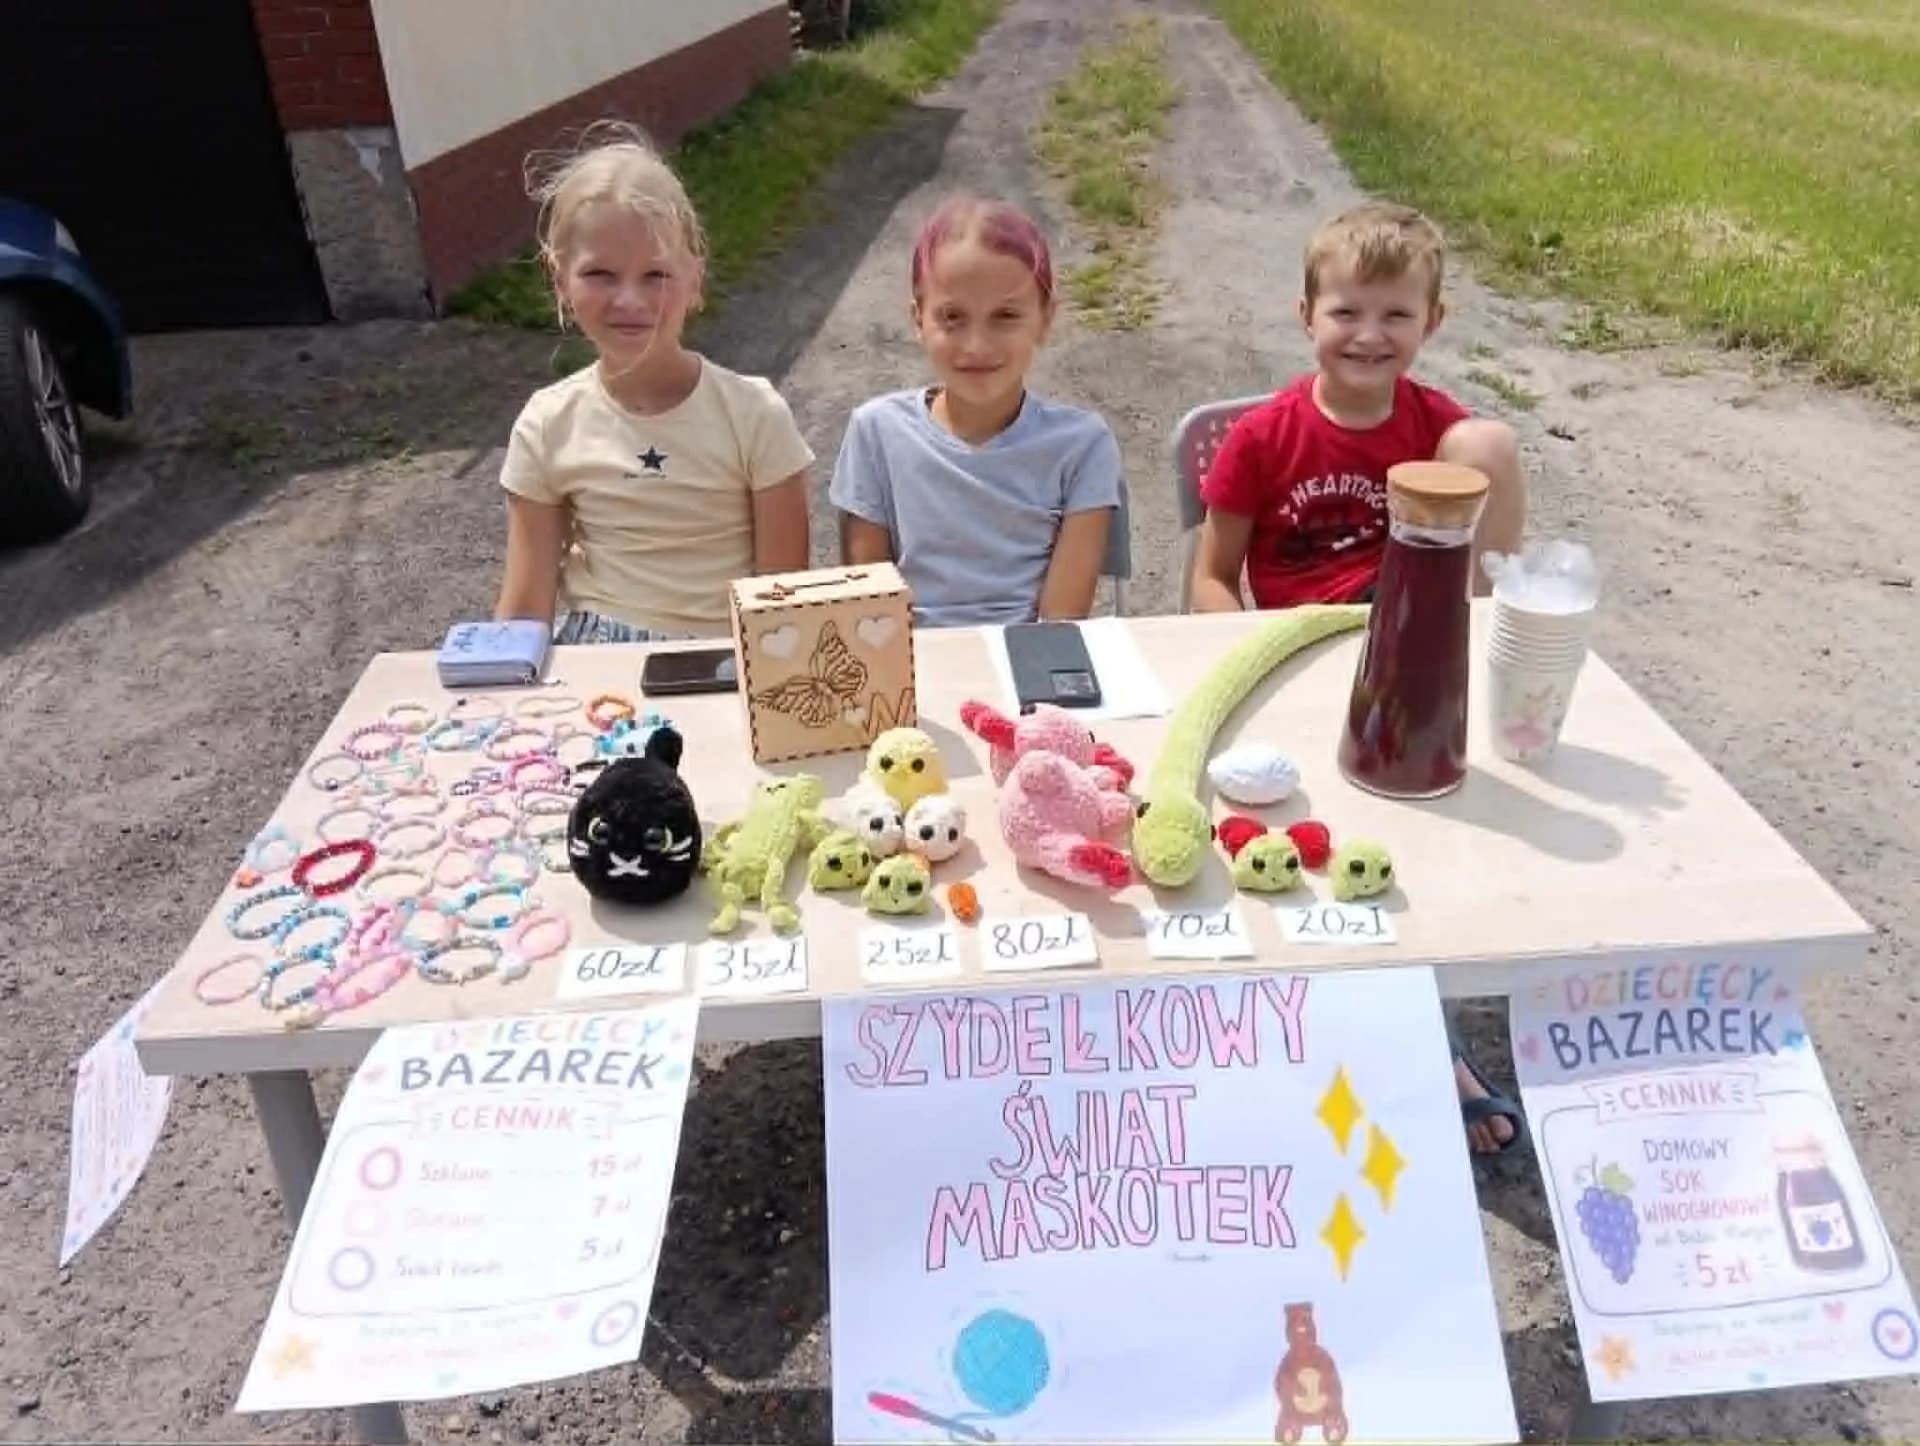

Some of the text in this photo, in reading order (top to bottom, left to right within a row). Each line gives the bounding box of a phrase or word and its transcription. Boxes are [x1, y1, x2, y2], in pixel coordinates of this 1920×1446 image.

[992, 916, 1081, 959] 80zł
[1157, 911, 1238, 940] 70zł
[1298, 905, 1388, 937] 20zł
[576, 947, 668, 982] 60zł
[707, 942, 803, 986] 35zł
[867, 932, 953, 967] 25zł
[845, 977, 1310, 1088] SZYDEŁKOWY
[1547, 1006, 1779, 1071] BAZAREK
[400, 1047, 666, 1091] BAZAREK
[1618, 1080, 1727, 1110] CENNIK
[450, 1103, 578, 1131] CENNIK
[988, 1079, 1198, 1181] ŚWIAT
[1641, 1137, 1732, 1164] DOMOWY
[1660, 1170, 1704, 1194] SOK
[924, 1164, 1297, 1272] MASKOTEK
[1694, 1251, 1718, 1289] 5
